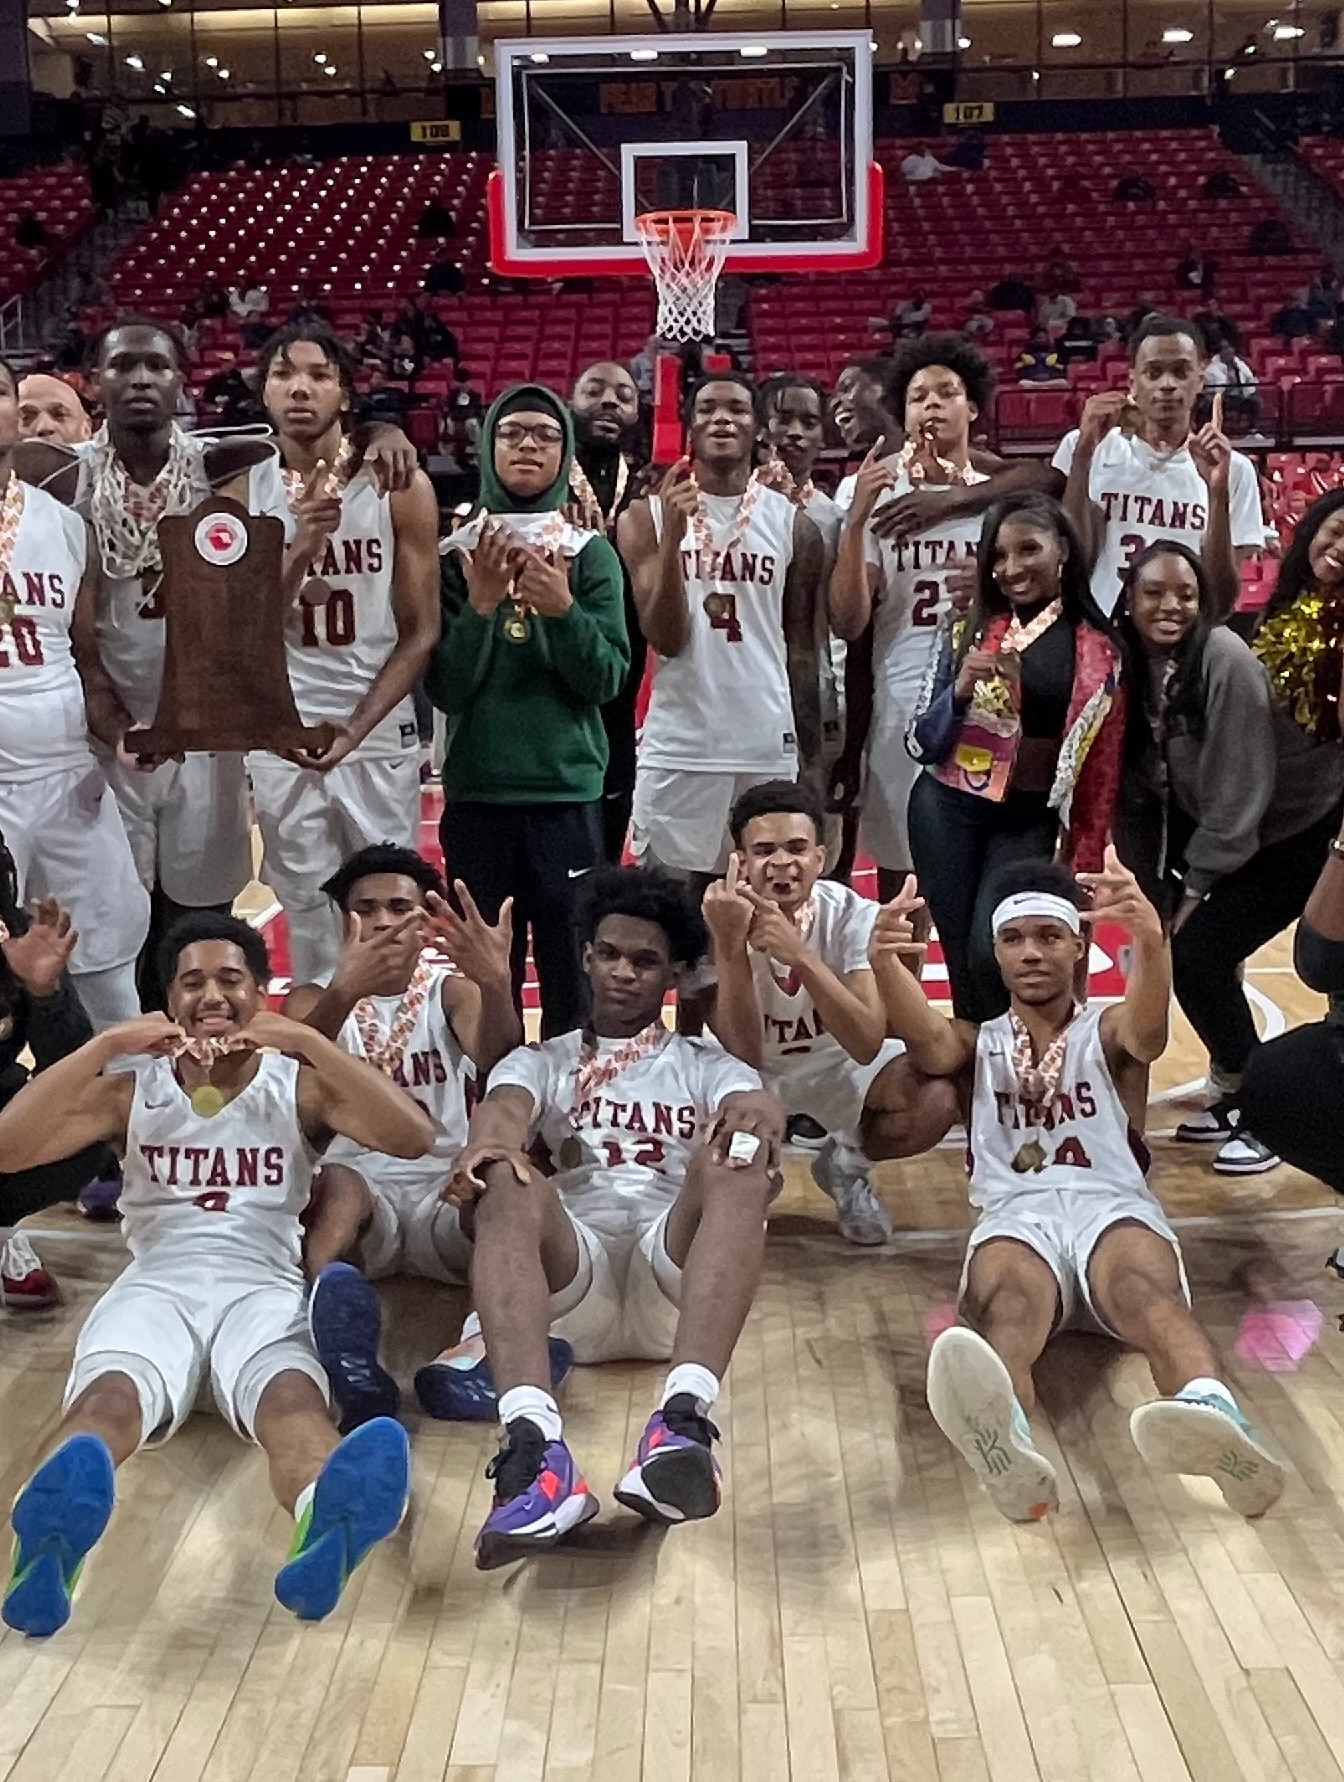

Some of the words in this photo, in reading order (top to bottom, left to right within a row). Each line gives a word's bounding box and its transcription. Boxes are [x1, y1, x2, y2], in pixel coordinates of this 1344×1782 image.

[1100, 492, 1207, 530] TITANS
[890, 540, 977, 572] TITA
[298, 588, 357, 648] 10
[912, 580, 945, 626] 2
[139, 1144, 285, 1188] TITANS
